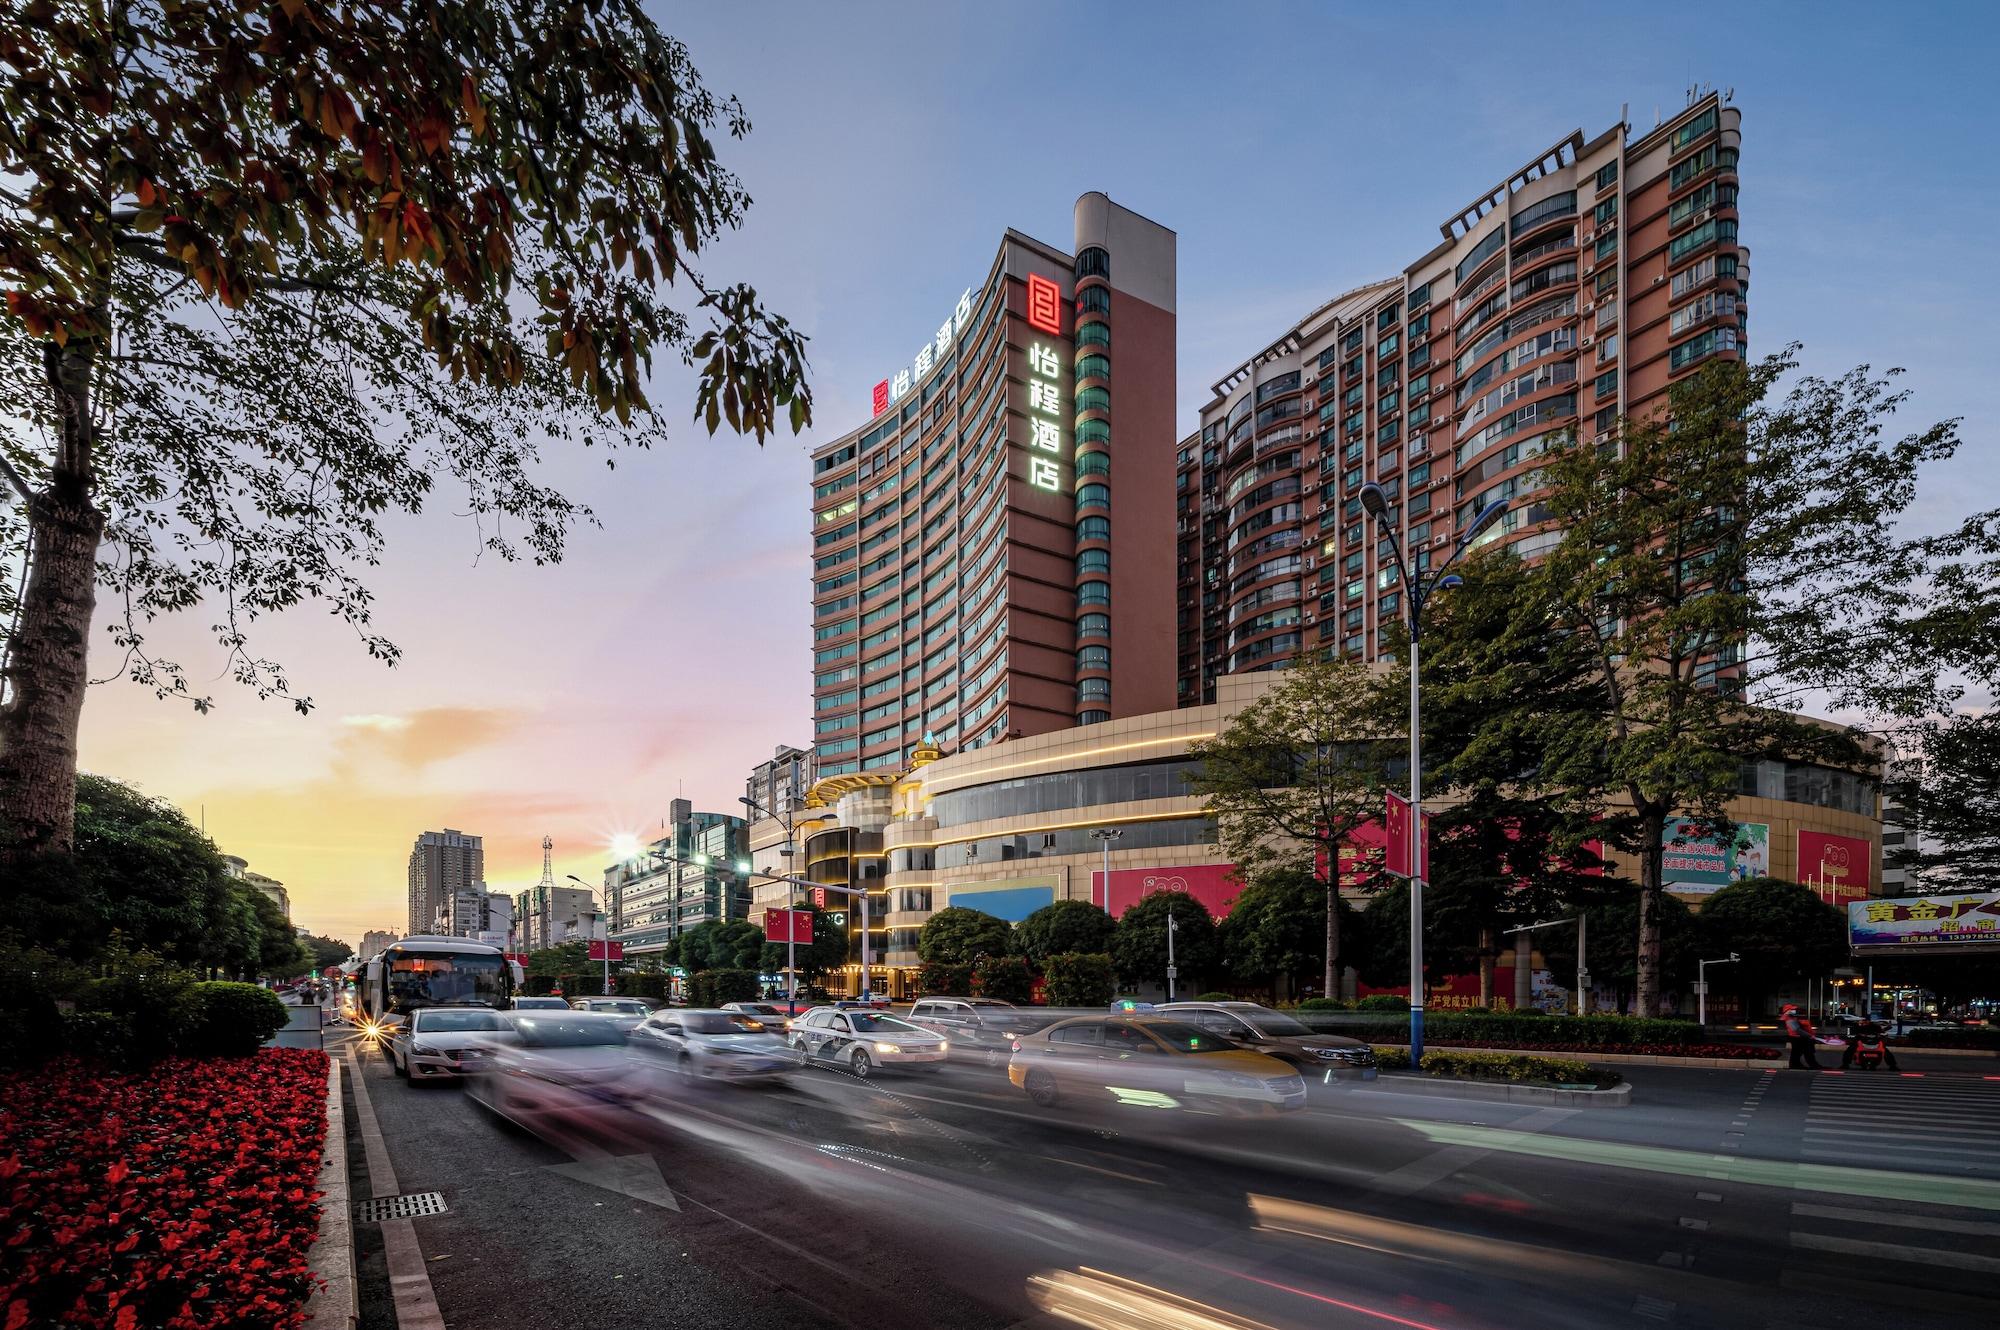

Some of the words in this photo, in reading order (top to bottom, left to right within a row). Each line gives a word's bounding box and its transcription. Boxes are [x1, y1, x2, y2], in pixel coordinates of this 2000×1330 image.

[891, 287, 971, 400] 怡程酒店
[1029, 341, 1060, 491] 怡程酒店
[1866, 896, 2000, 923] 黄金广
